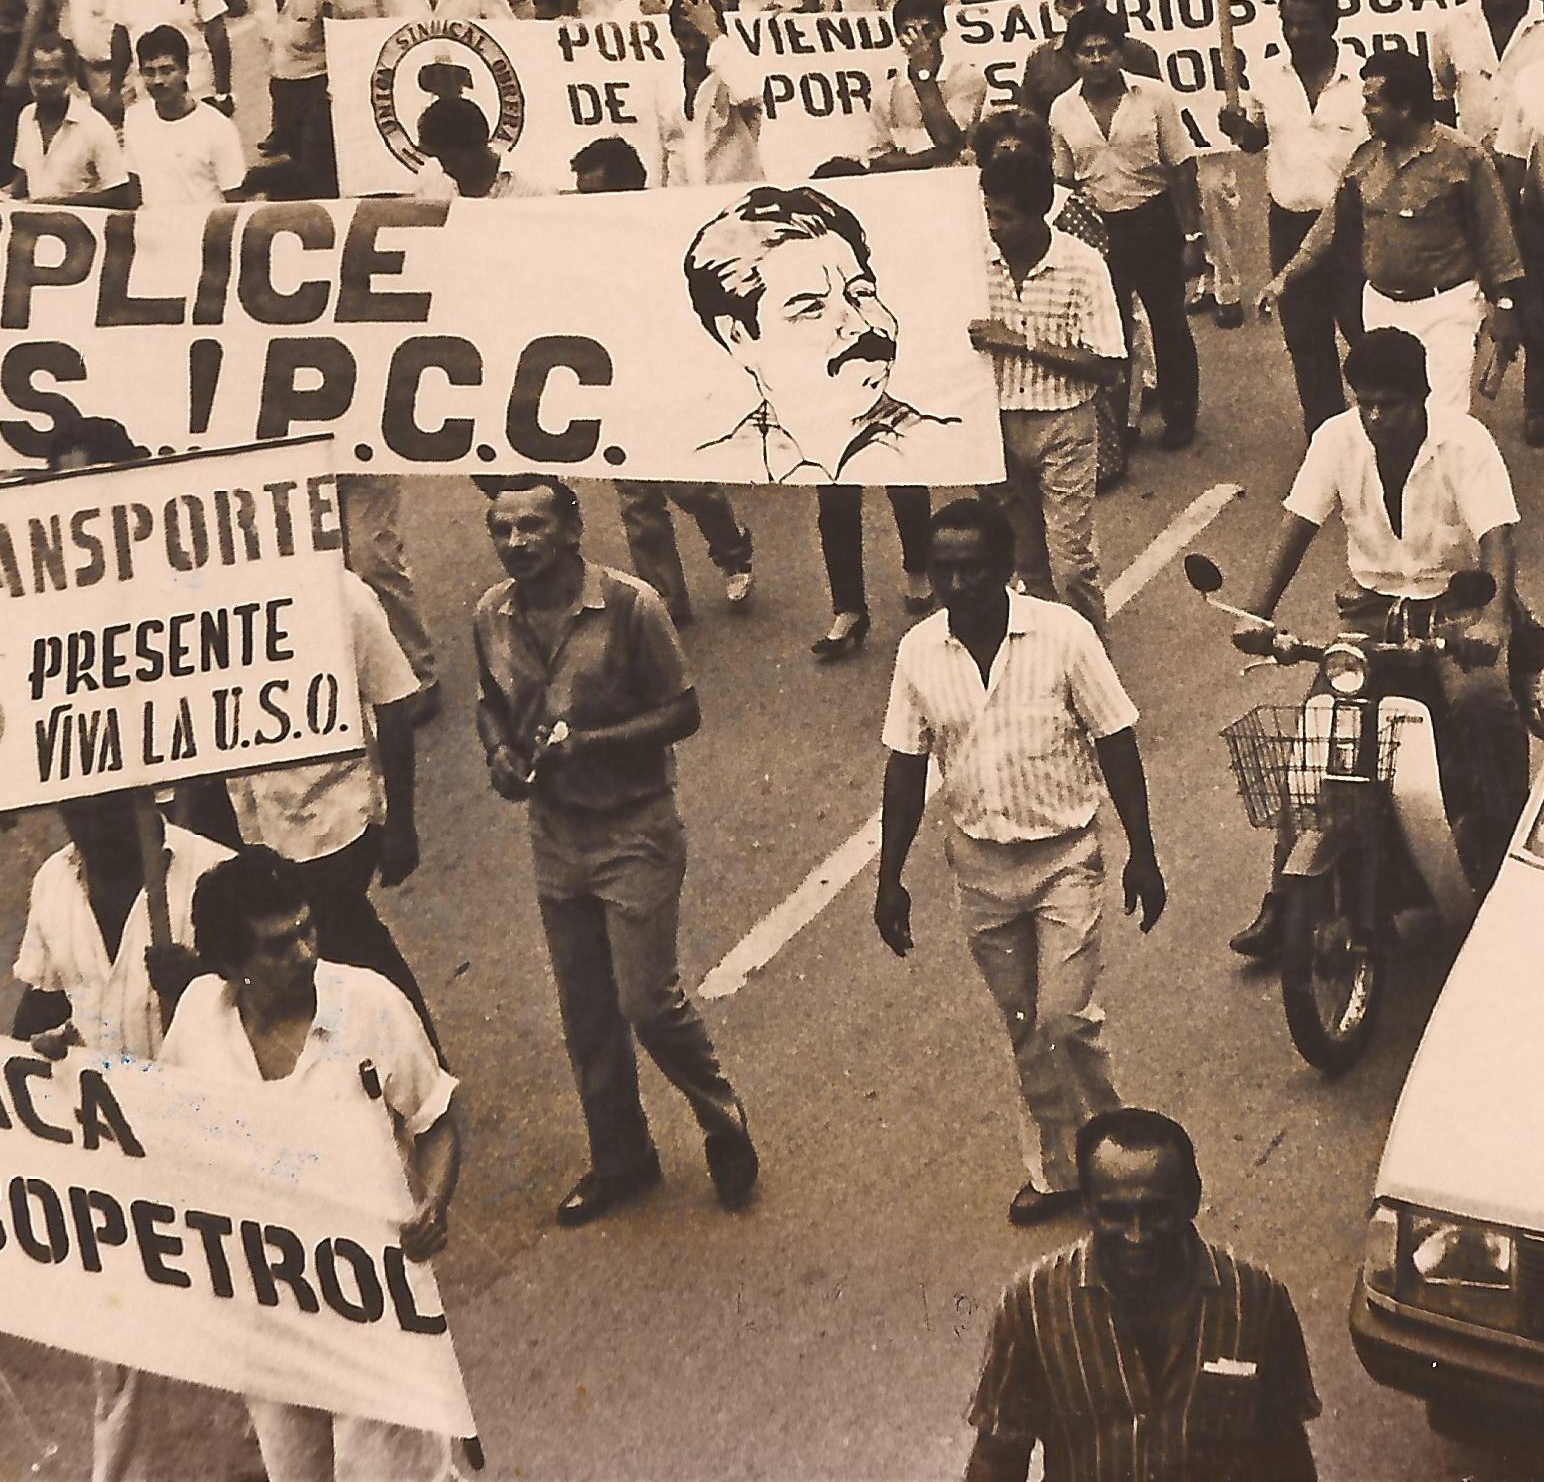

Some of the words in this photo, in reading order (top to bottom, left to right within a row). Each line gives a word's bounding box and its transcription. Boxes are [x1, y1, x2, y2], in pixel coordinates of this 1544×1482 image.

[374, 66, 400, 137] UNION
[395, 19, 489, 52] SINDICAL
[557, 20, 667, 64] POR
[566, 81, 638, 126] DE
[762, 69, 872, 122] POR
[27, 597, 295, 701] PRESENTE
[34, 701, 123, 783] VIVA
[142, 696, 198, 767] LA
[211, 672, 350, 753] U.S.O.
